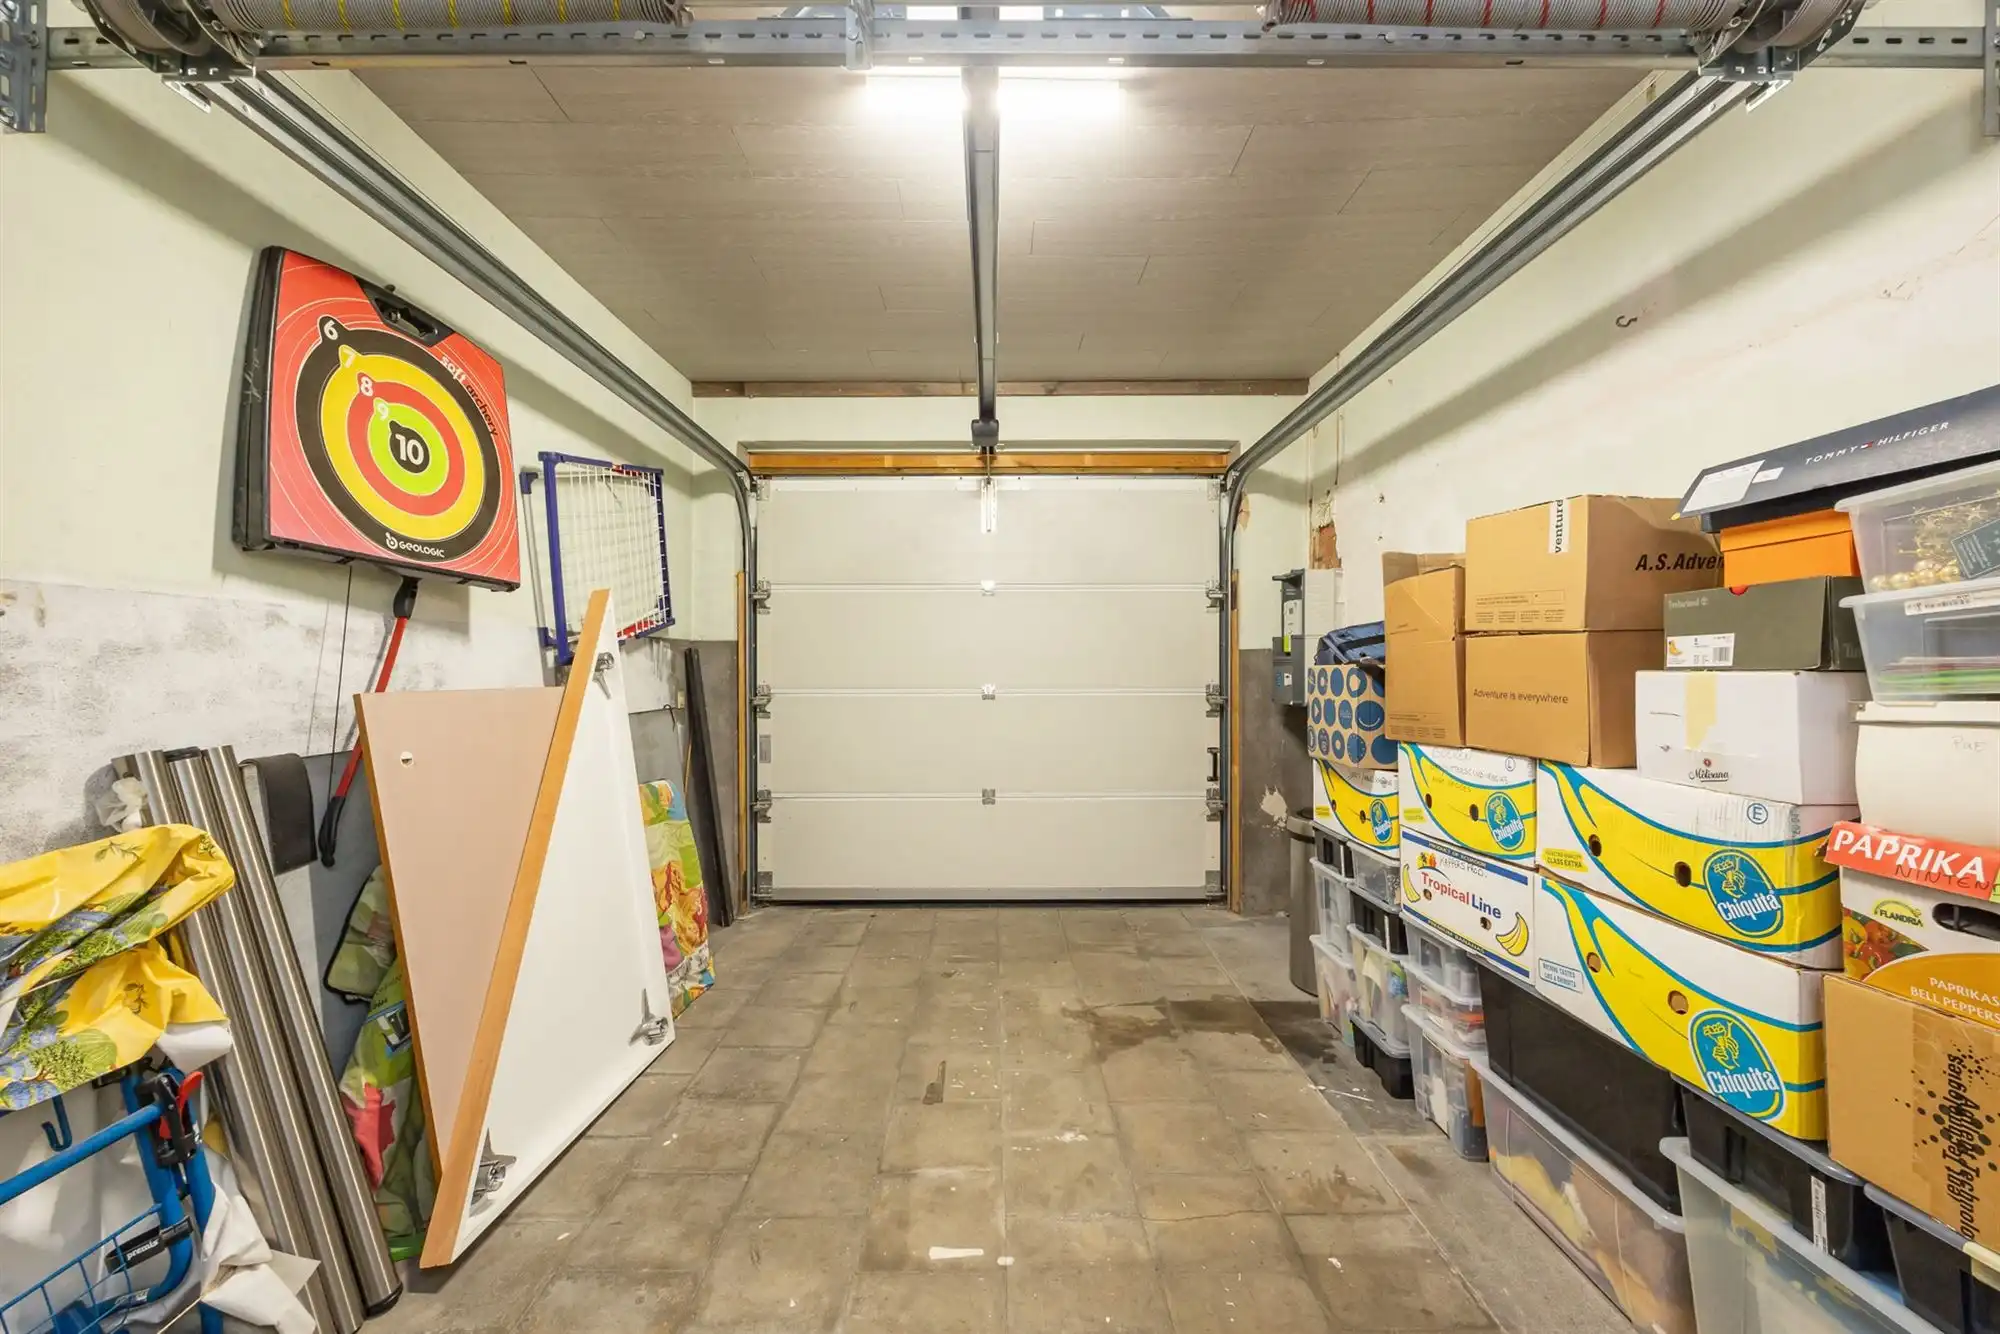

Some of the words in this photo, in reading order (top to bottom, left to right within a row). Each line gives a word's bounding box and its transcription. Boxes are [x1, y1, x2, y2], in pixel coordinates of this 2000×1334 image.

[323, 320, 339, 341] 6
[342, 350, 356, 368] 7
[360, 376, 374, 396] 8
[442, 356, 467, 380] soft
[466, 384, 498, 436] archery
[377, 402, 390, 420] 9
[394, 433, 425, 465] 10
[1805, 445, 1858, 466] TOMMY
[1877, 421, 1950, 446] HILFIGER
[1554, 499, 1565, 554] venture
[1473, 688, 1508, 700] Adventure
[1509, 690, 1516, 701] is
[1517, 692, 1569, 704] everywhere
[1494, 818, 1526, 841] Chiquita
[1565, 859, 1583, 868] EXTRA
[1833, 829, 1987, 884] PAPRIKA
[1421, 872, 1470, 905] Tropical
[1471, 894, 1502, 919] Line
[1717, 893, 1782, 920] Chiquita
[1879, 909, 1924, 928] FLANDRIA
[1928, 976, 2000, 1007] PAPRIKAS
[1910, 986, 1942, 1005] BELL
[1942, 996, 2000, 1025] PEPPERS
[1707, 1069, 1776, 1099] Chiquita
[126, 1238, 159, 1260] premis
